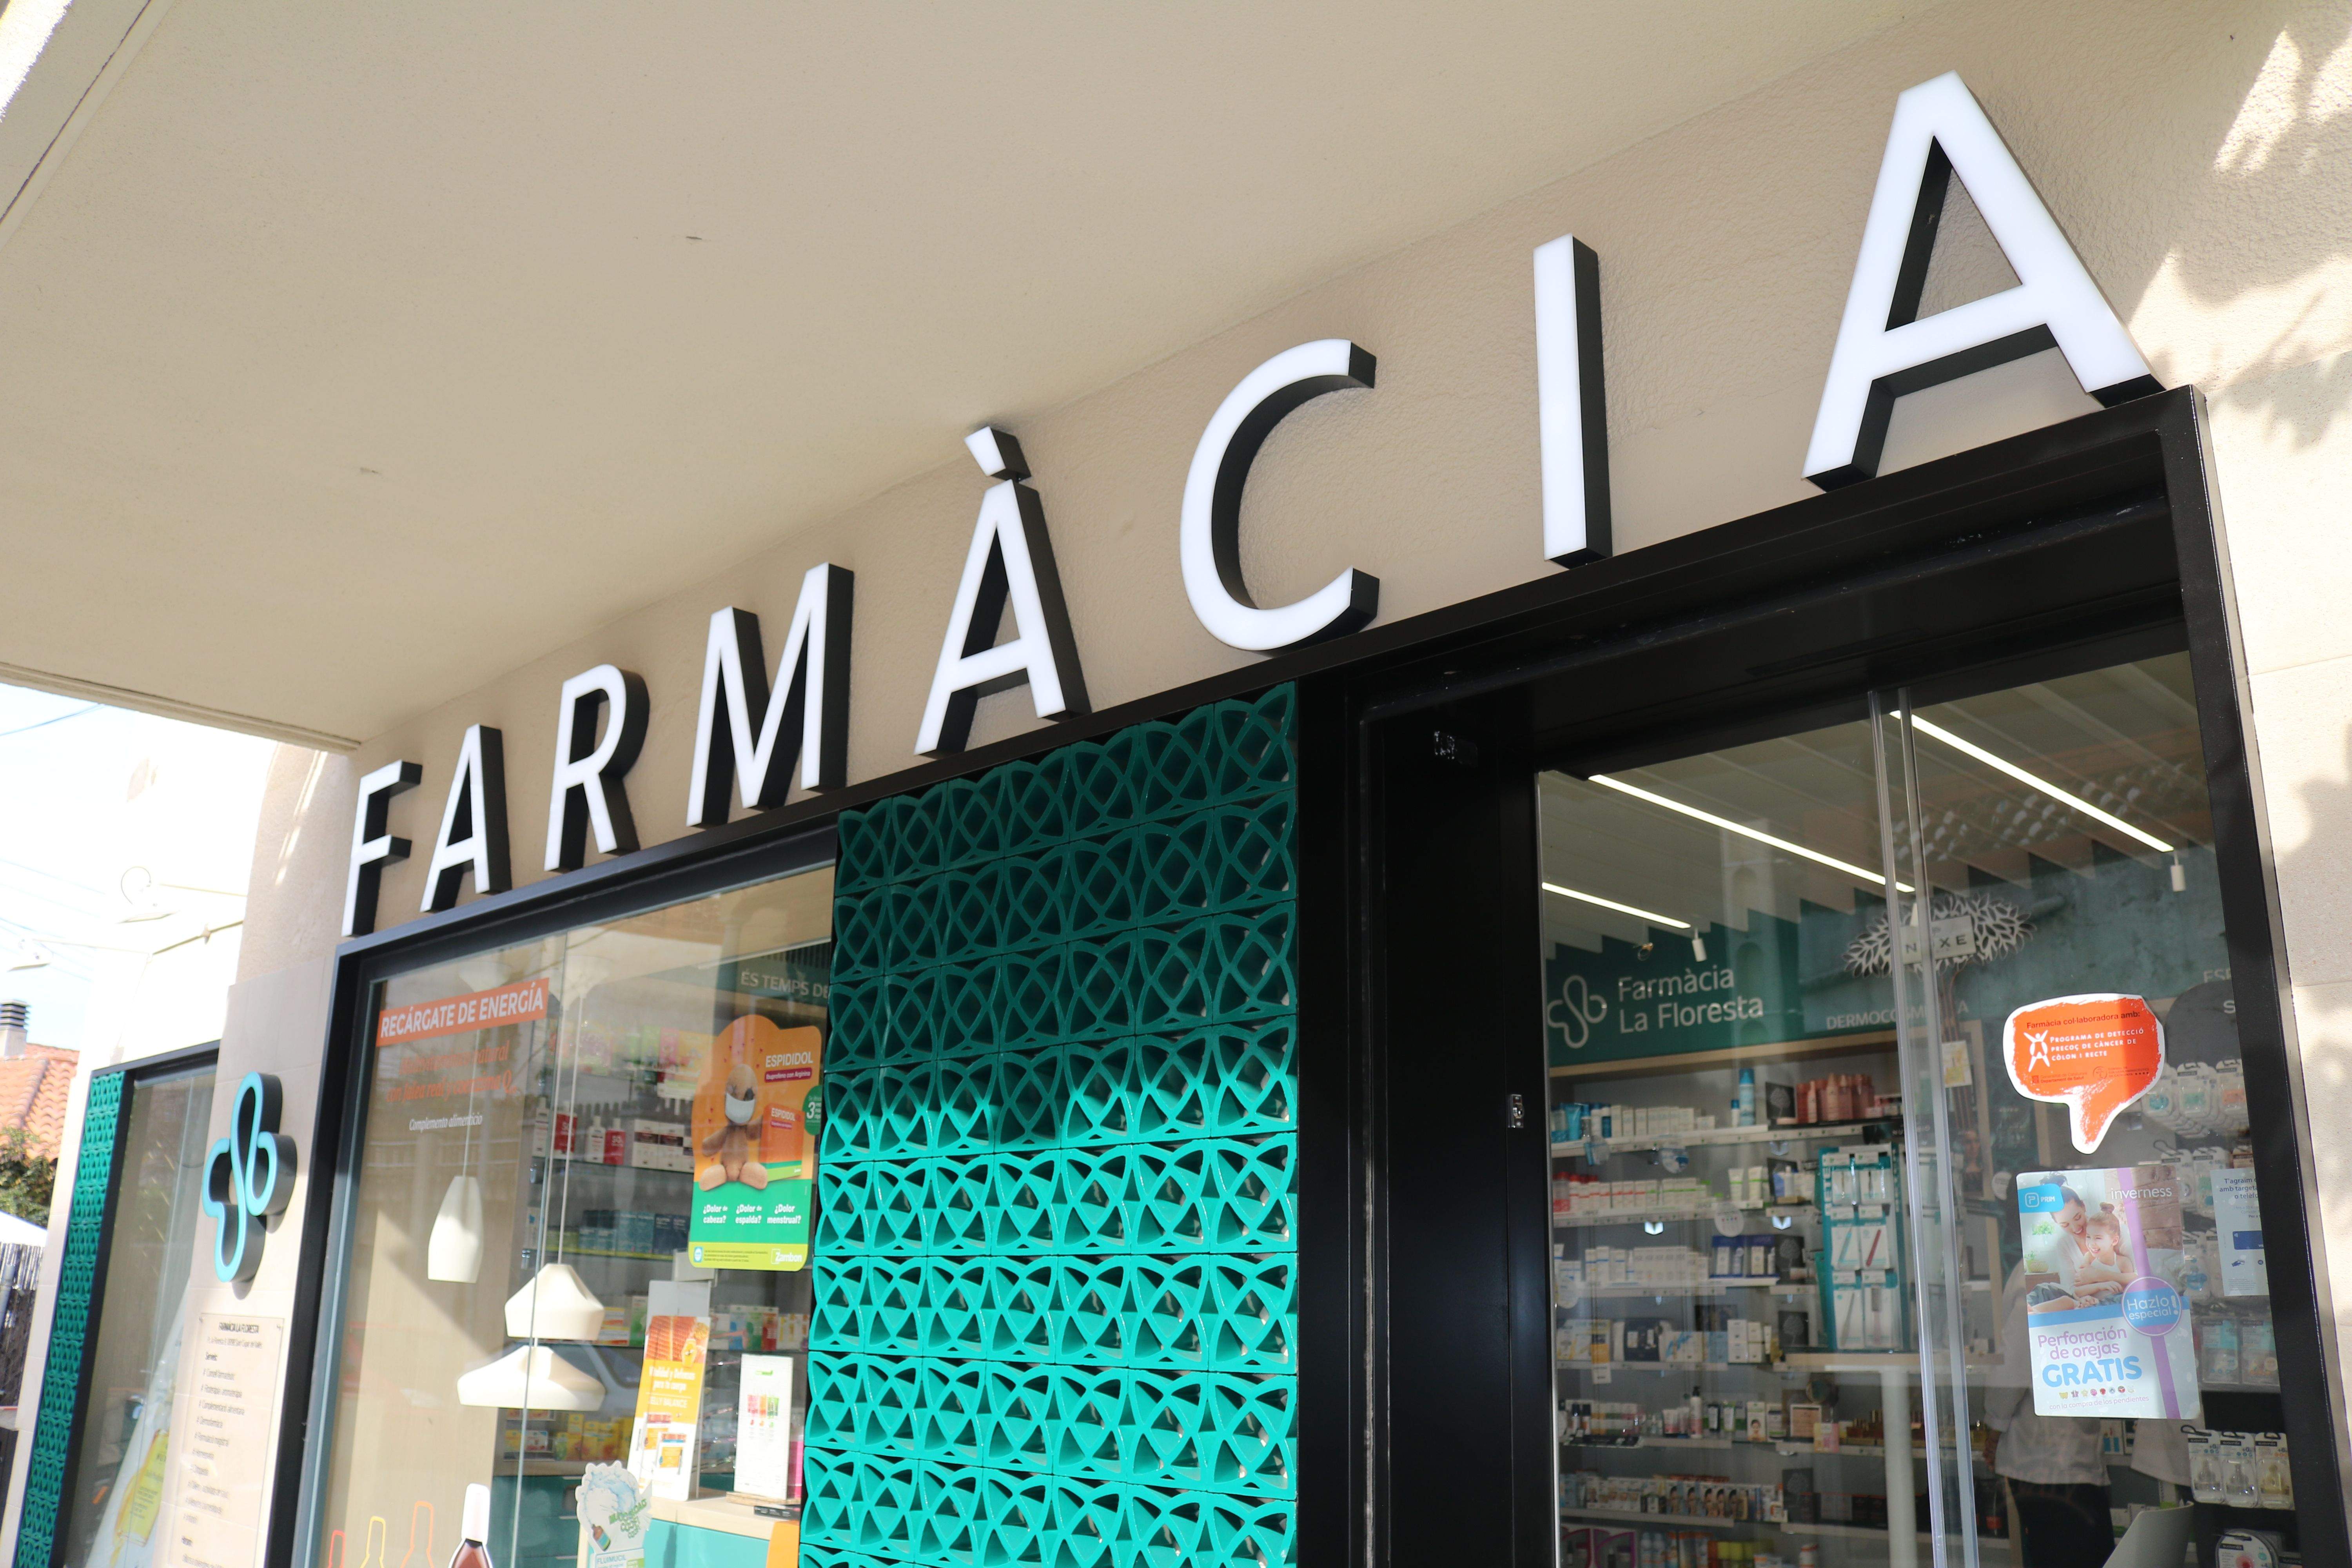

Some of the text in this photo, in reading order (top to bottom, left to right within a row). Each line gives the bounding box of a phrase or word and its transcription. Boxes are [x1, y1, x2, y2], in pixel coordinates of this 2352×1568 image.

[339, 71, 2156, 937] FARMÀCIA
[1905, 934, 1967, 954] NXE
[741, 968, 759, 987] ÉS
[762, 975, 809, 996] TEMPS
[1618, 965, 1735, 1002] Farmàcia
[380, 982, 544, 1038] RECÁRGATE DE ENERGÍA
[1620, 995, 1764, 1034] La Floresta
[2027, 1011, 2140, 1029] Farmàcia col·laboradora amb:
[2050, 1033, 2092, 1044] PROGRAMA
[2107, 1027, 2144, 1038] DETECCIÓ
[2094, 1040, 2124, 1048] CÀNCER
[765, 1051, 813, 1068] ESPIDIDOL
[2051, 1052, 2077, 1062] CÒLON
[771, 1107, 796, 1122] ESPIDIDOL
[806, 1101, 815, 1120] 3
[409, 1112, 483, 1133] Complemento alimenticio
[2111, 1187, 2172, 1200] inverness
[703, 1204, 722, 1214] ¿Dolor
[736, 1204, 755, 1214] ¿Dolor
[774, 1204, 795, 1214] ¿Dolor
[703, 1215, 727, 1224] cabeza?
[735, 1215, 762, 1225] espalda?
[767, 1215, 802, 1224] menstrual?
[775, 1252, 802, 1263] Zambon
[2127, 1295, 2169, 1311] Hazlo
[2038, 1325, 2127, 1348] Perforación
[2050, 1342, 2120, 1360] de orejas
[2042, 1356, 2142, 1388] GRATIS
[2062, 1401, 2068, 1409] la
[2069, 1401, 2093, 1410] compra
[2103, 1397, 2112, 1405] los
[2113, 1395, 2149, 1405] pendientes
